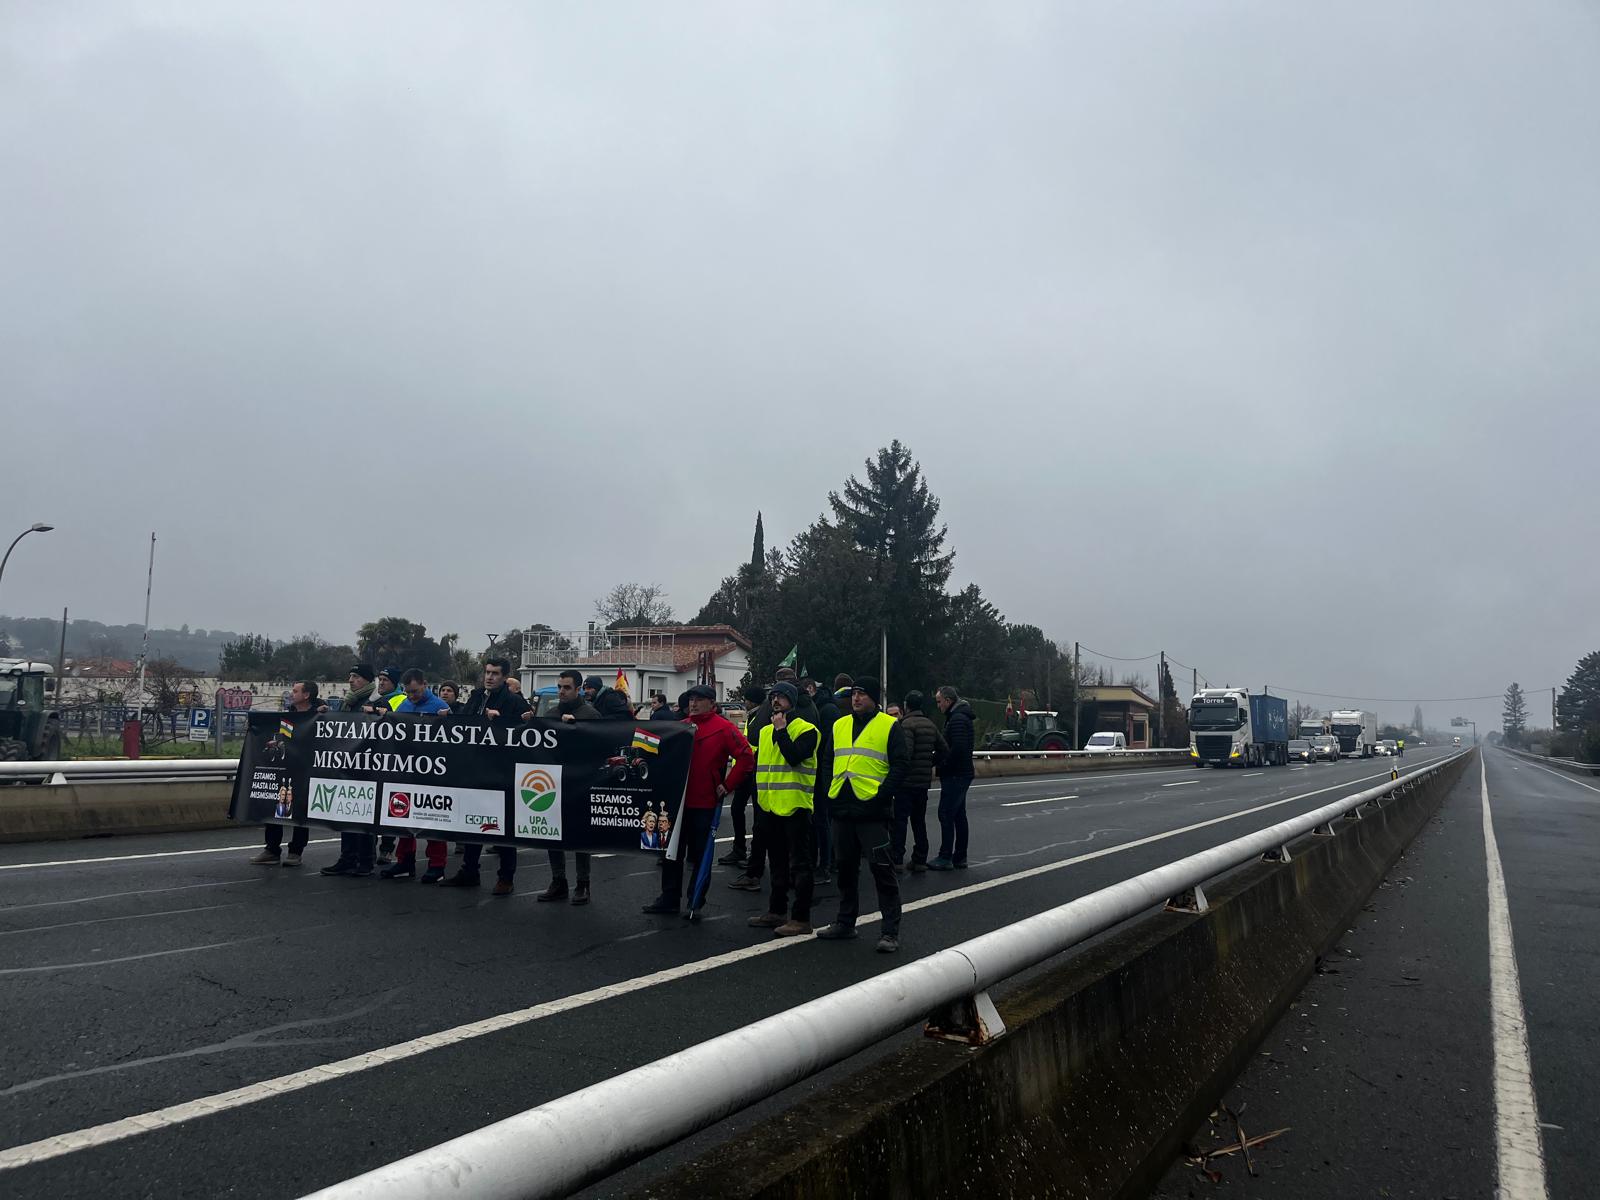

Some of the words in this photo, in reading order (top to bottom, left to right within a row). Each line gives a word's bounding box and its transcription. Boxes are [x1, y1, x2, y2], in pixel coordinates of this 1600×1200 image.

[194, 710, 207, 725] P
[315, 720, 407, 741] ESTAMOS
[412, 723, 498, 746] HASTA
[504, 727, 558, 749] LOS
[313, 747, 447, 776] MISMÍSIMOS
[253, 772, 277, 781] ESTAMOS
[251, 781, 268, 790] HASTA
[249, 790, 281, 800] MISMÍSIMOS
[338, 785, 374, 800] ARAG
[414, 793, 453, 812] UAGR
[590, 793, 632, 804] ESTAMOS
[336, 801, 373, 816] ASAJA
[590, 805, 620, 815] HASTA
[621, 806, 640, 816] LOS
[465, 814, 498, 825] COAG
[529, 815, 548, 825] UPA
[590, 815, 646, 828] MISMÍSIMOS
[518, 825, 529, 834] LA
[531, 826, 560, 836] RIOJA
